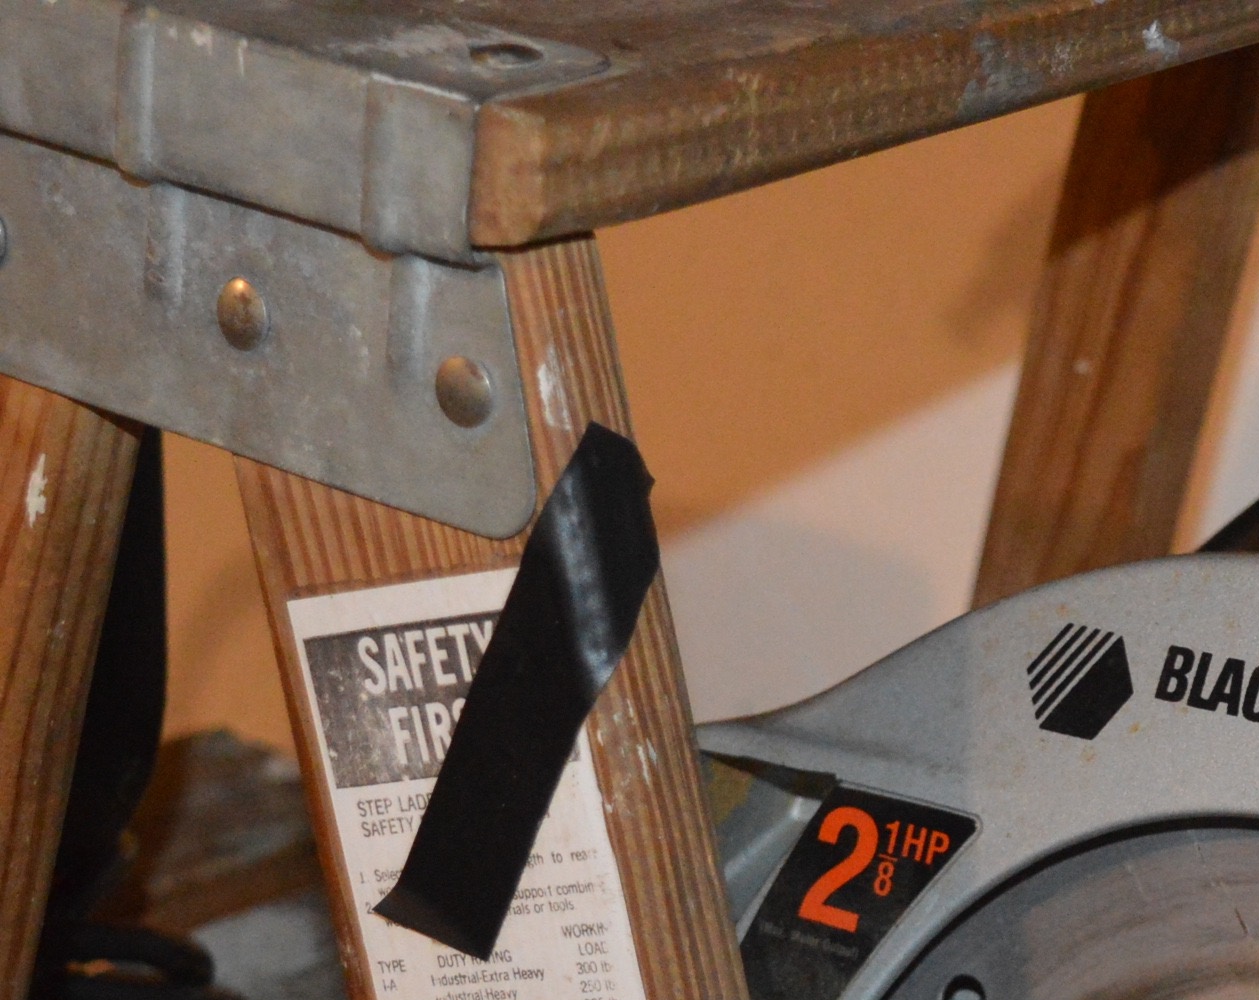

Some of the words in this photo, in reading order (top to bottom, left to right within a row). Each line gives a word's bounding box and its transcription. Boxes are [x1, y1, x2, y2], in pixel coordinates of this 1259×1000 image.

[358, 620, 494, 694] SAFETY
[358, 800, 392, 817] STEP
[362, 817, 413, 837] SAFETY
[798, 806, 879, 933] 2
[902, 824, 950, 865] HP
[550, 900, 574, 912] tools
[378, 960, 406, 974] TYPE
[438, 954, 466, 969] DUTY
[513, 968, 544, 981] Heavy
[576, 962, 597, 975] 300
